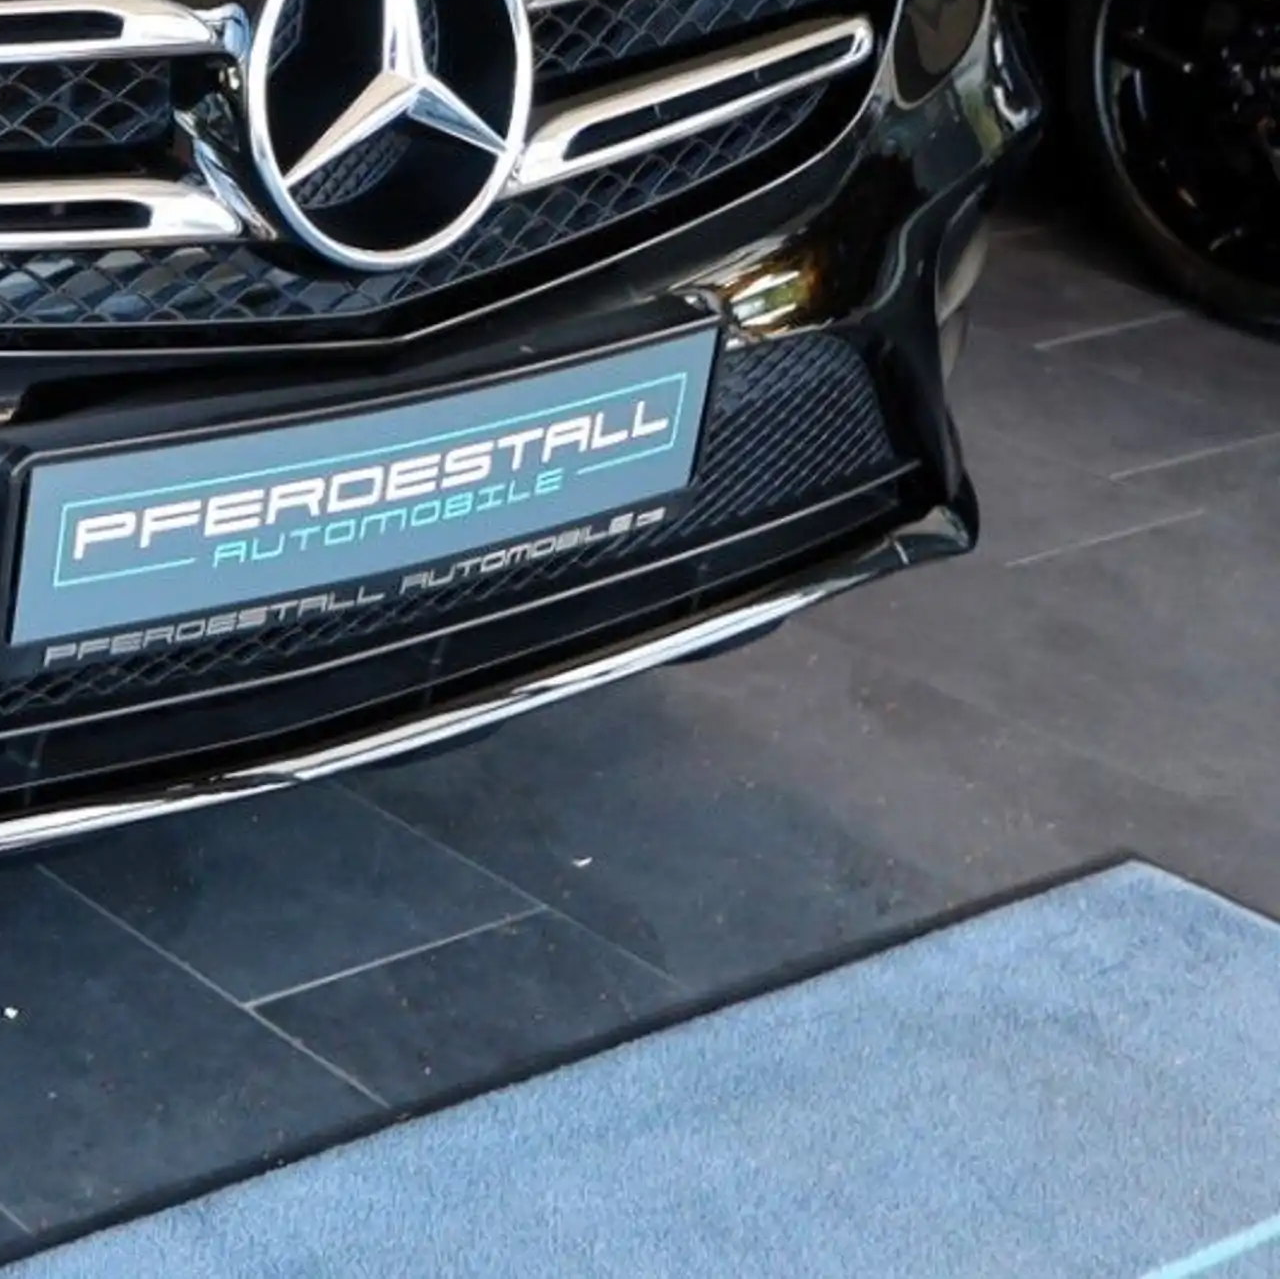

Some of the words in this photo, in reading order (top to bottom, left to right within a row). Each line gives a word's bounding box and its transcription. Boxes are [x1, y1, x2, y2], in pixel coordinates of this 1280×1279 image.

[72, 400, 668, 559] PFERDESTALL
[211, 469, 562, 567] AUTOMOBILE
[43, 587, 386, 667] PFERDESTALL
